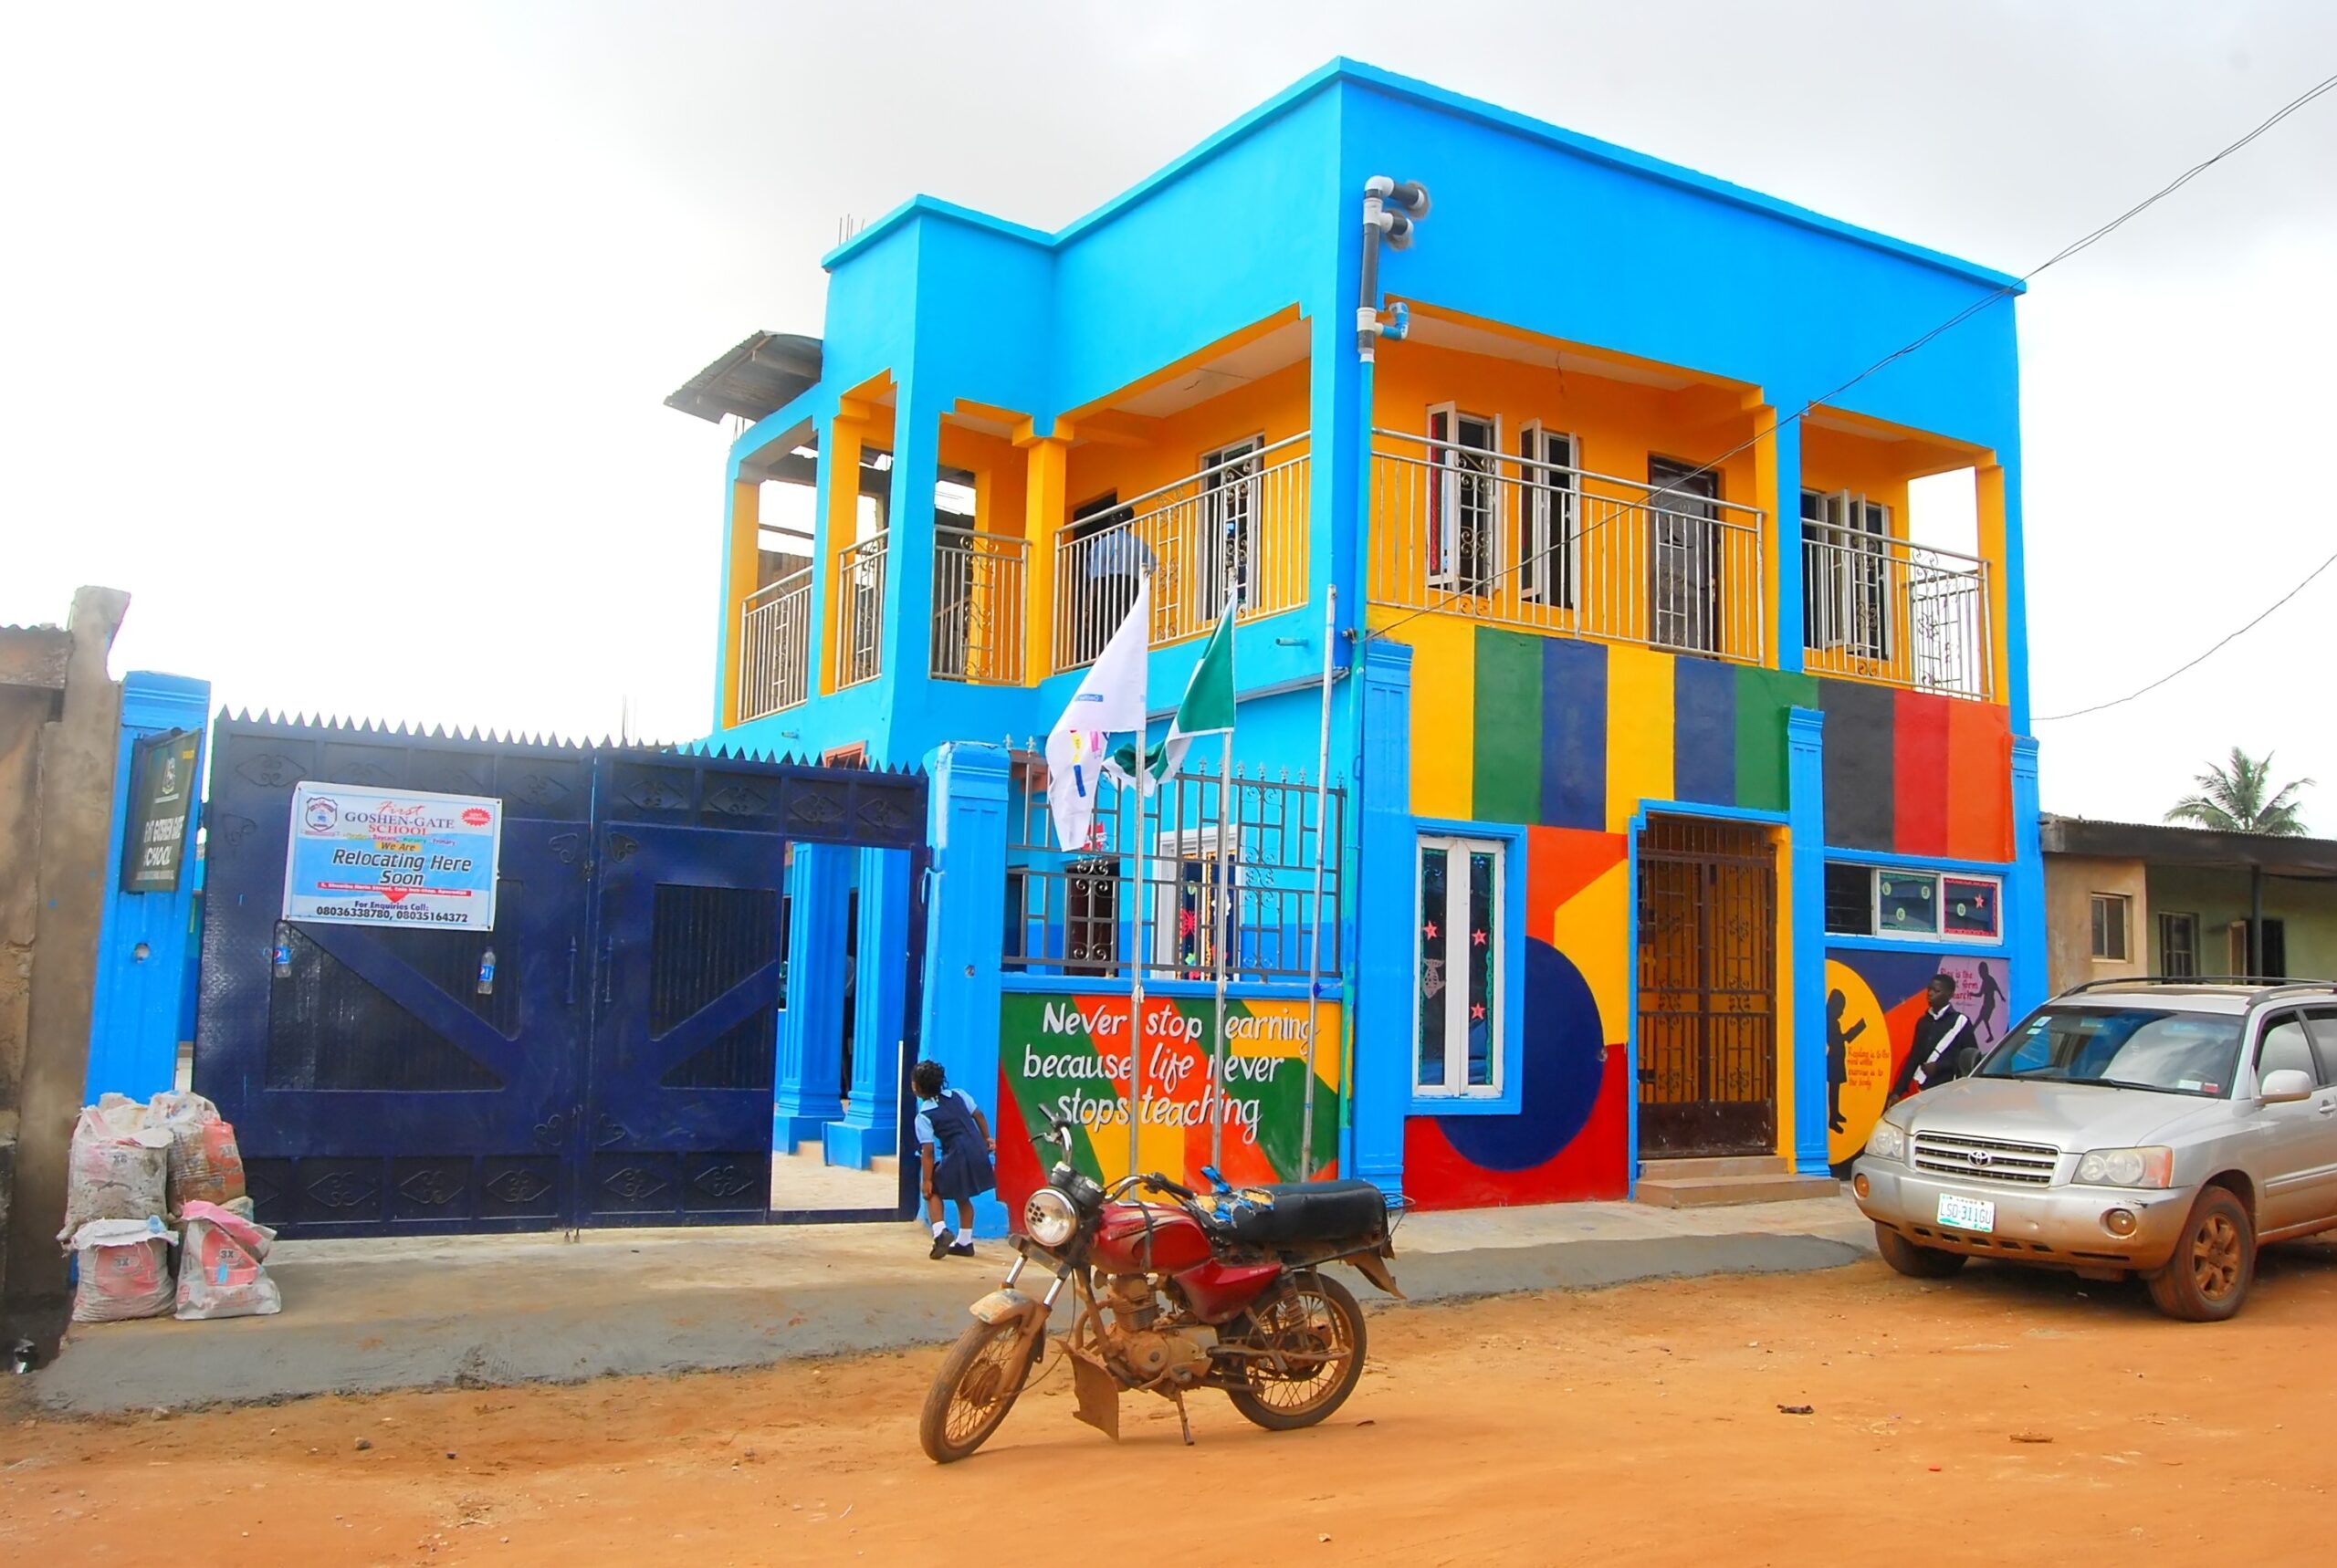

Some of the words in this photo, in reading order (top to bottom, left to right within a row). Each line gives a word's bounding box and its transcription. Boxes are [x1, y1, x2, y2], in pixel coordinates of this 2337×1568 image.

[376, 801, 425, 816] First
[344, 811, 455, 829] GOSHEN-GATE
[368, 823, 428, 836] SCHOOL
[381, 841, 396, 850] We
[398, 842, 415, 851] Are
[332, 849, 424, 871] Relocating
[430, 854, 471, 872] Here
[380, 870, 424, 886] Soon
[354, 900, 368, 908] For
[371, 901, 408, 912] Enquiries
[316, 906, 393, 920] 08036338780,
[396, 910, 467, 923] 08035164372
[1042, 1001, 1128, 1036] Never
[1145, 1005, 1203, 1043] stop
[1022, 1043, 1132, 1081] because
[1148, 1042, 1195, 1093] life
[1058, 1087, 1132, 1133] stops
[220, 1249, 235, 1259] 3X
